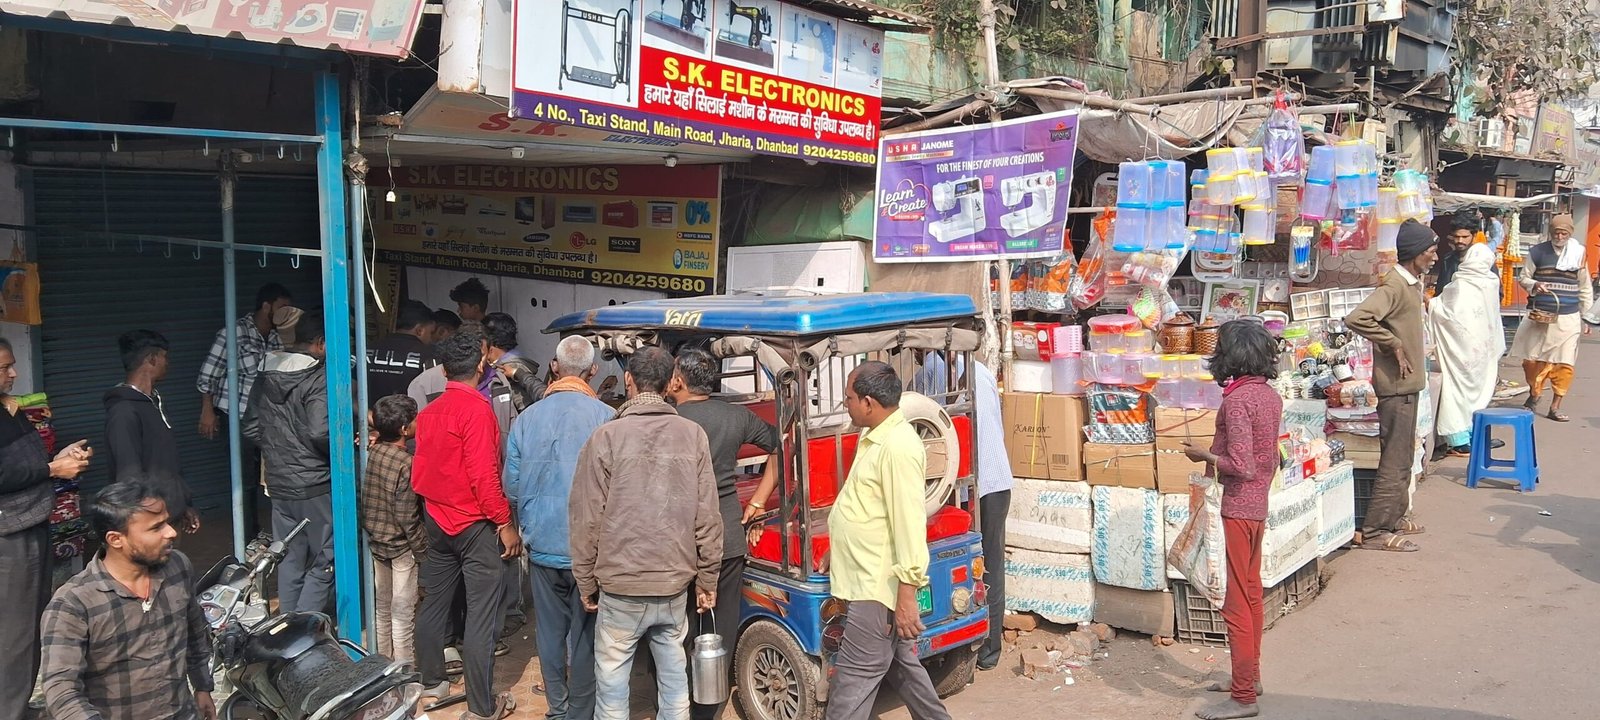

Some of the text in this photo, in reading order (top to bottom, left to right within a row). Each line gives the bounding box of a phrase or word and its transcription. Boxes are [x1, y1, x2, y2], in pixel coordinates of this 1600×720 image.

[582, 11, 602, 23] USHA
[663, 57, 865, 117] S.K. ELECTRONICS
[644, 82, 672, 105] हमारे
[674, 86, 693, 110] यहाँ
[695, 89, 726, 118] सिलाई
[728, 95, 755, 120] मशीन
[757, 101, 768, 122] के
[769, 108, 799, 128] मरम्मत
[800, 108, 812, 129] की
[813, 111, 837, 139] सुविधा
[839, 119, 865, 138] उपलब्ध
[534, 102, 876, 164] 4 No., Taxi Stand, Main Road, Jharia, Dhanbad 9204259680
[888, 140, 954, 154] USHA JANOME
[936, 152, 1044, 173] FOR THE FINEST OF YOUR CREATIONS
[409, 165, 619, 191] S.K. ELECTRONICS
[880, 188, 915, 208] Learn
[888, 198, 928, 217] Create
[685, 200, 711, 225] 0%
[585, 238, 597, 246] LG
[684, 251, 710, 260] BAJAJ
[684, 261, 710, 270] FINSERV
[436, 256, 459, 266] Main
[462, 259, 491, 271] Road,
[494, 262, 530, 275] Jharia,
[533, 264, 585, 279] Dhanbad
[591, 271, 706, 293] 9204259680
[1168, 509, 1180, 518] DFS
